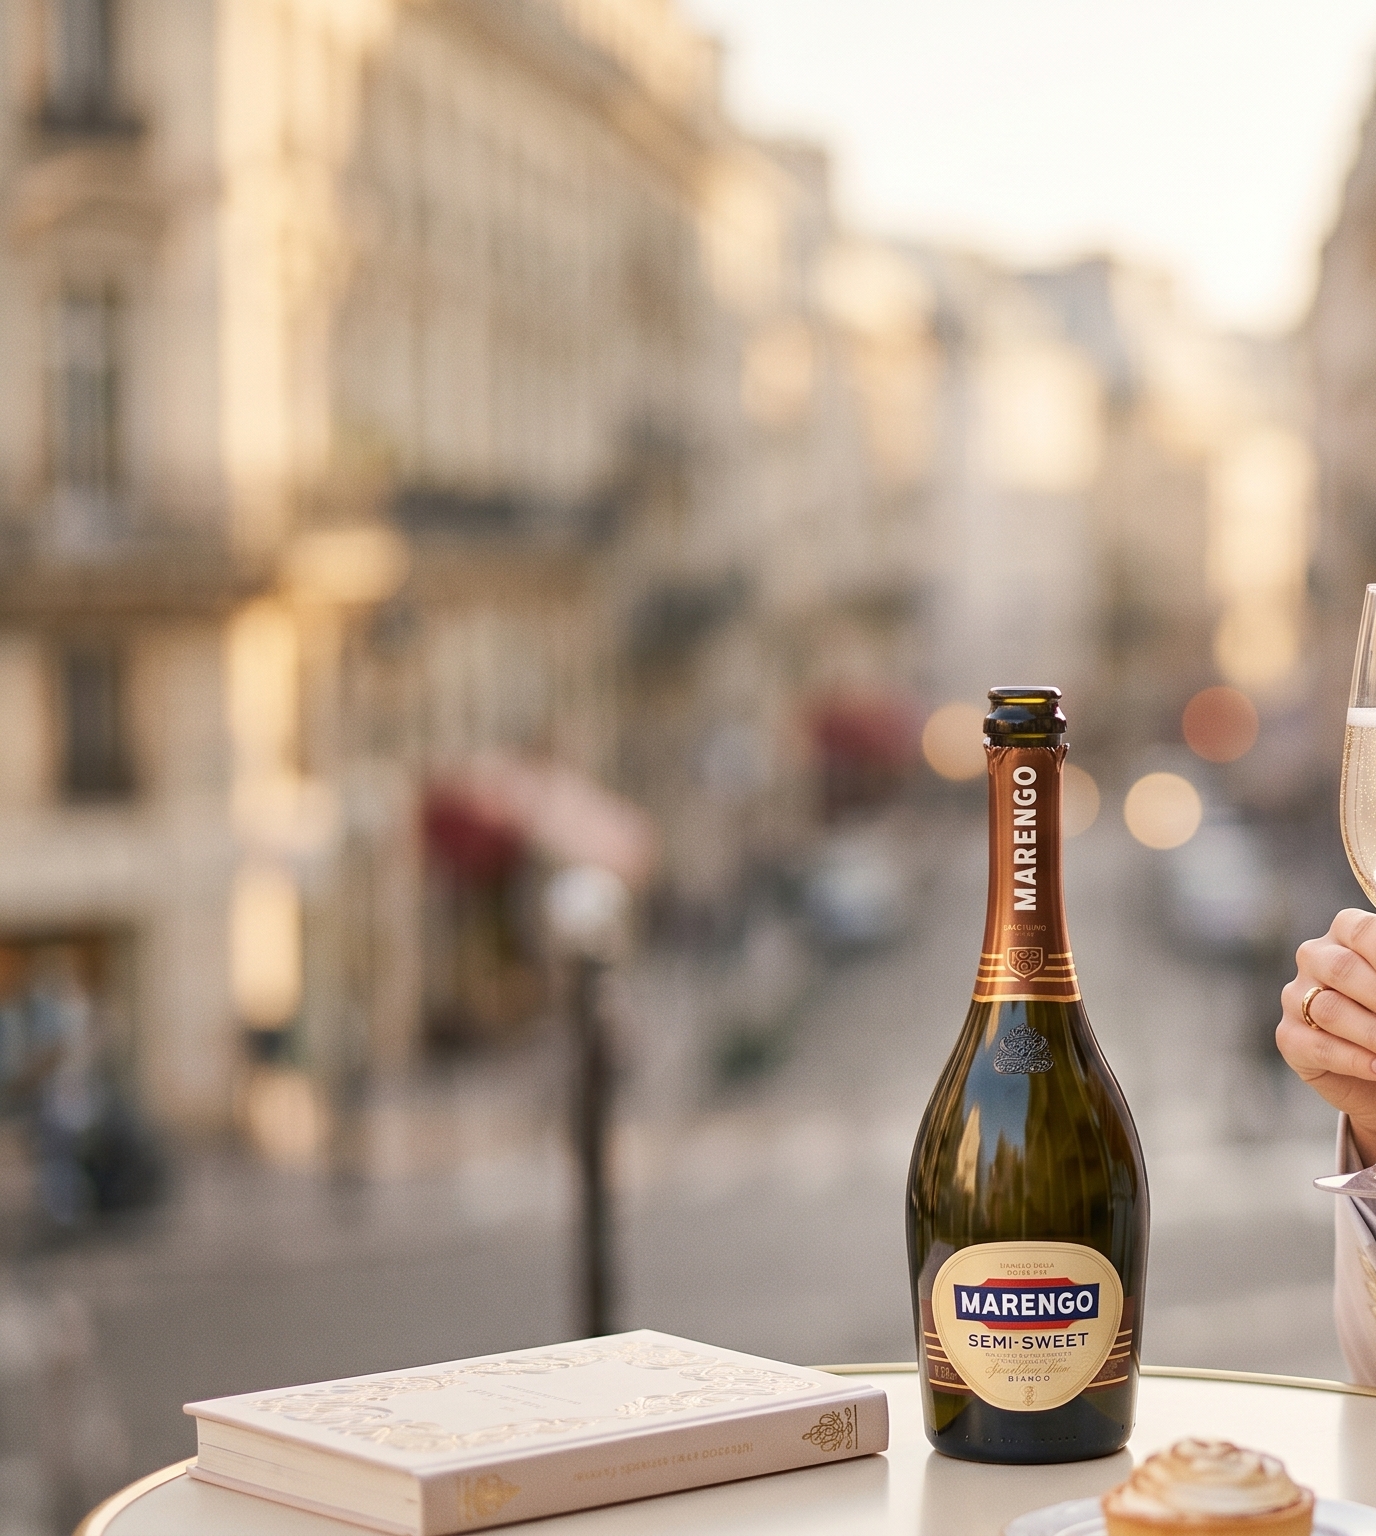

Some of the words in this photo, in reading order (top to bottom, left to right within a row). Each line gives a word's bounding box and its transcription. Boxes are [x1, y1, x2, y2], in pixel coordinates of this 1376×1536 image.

[1012, 766, 1037, 911] MARENGO
[961, 1290, 1094, 1316] MARENGO
[968, 1332, 1089, 1350] SEMI-SWEET
